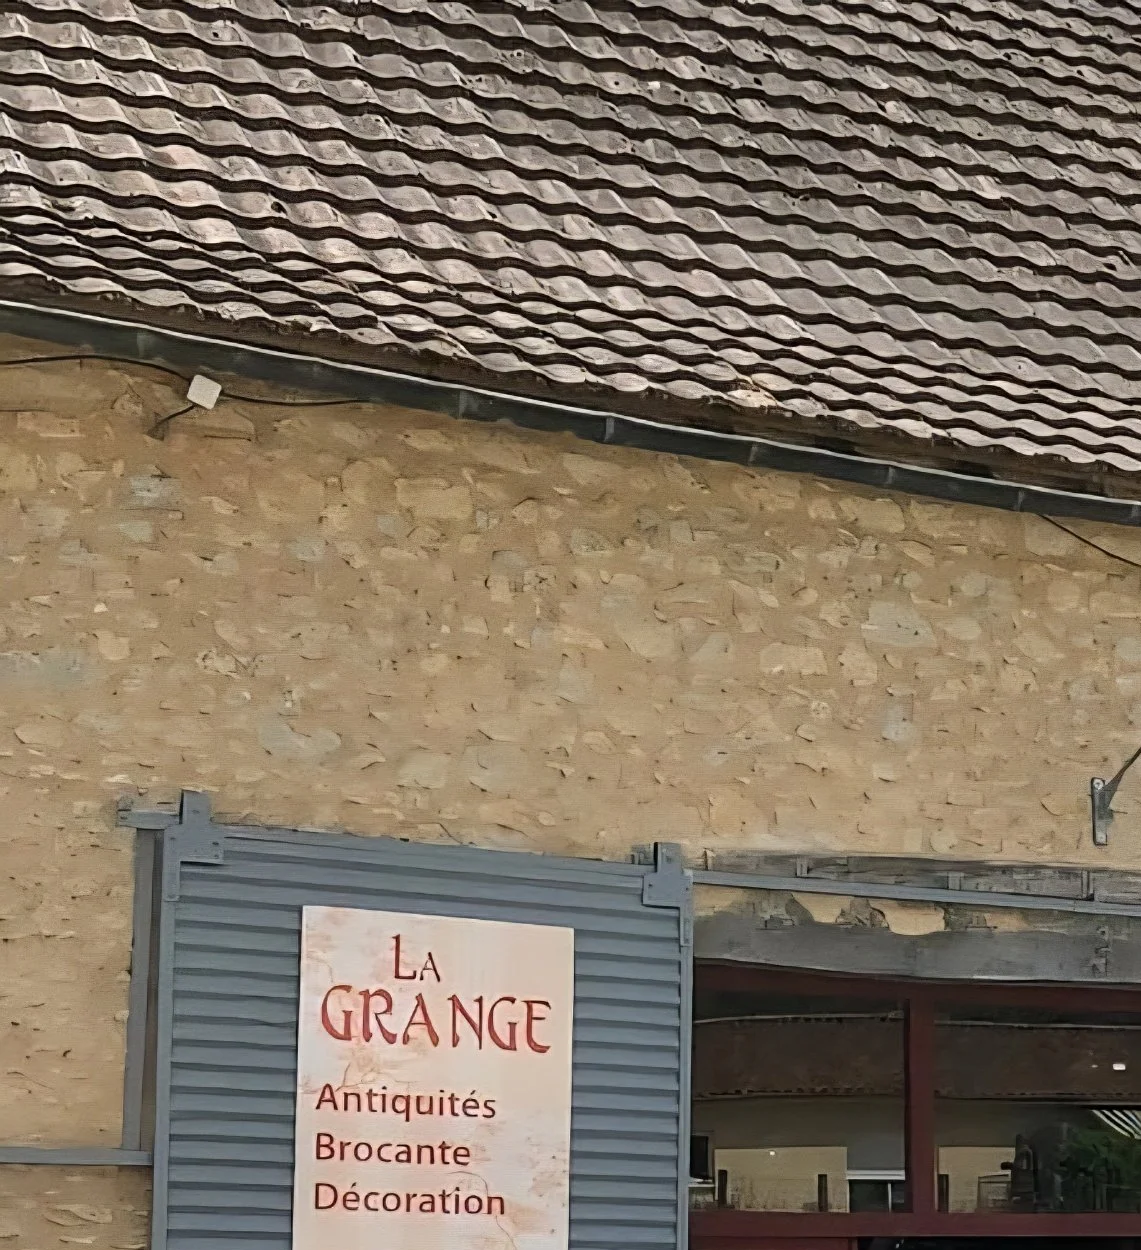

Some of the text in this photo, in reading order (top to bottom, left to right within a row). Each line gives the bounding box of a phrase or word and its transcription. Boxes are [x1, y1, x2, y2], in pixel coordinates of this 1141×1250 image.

[321, 984, 552, 1054] GRANGE
[315, 1083, 496, 1122] Antiquités
[315, 1132, 471, 1166] Brocante
[314, 1182, 505, 1215] Décoration
